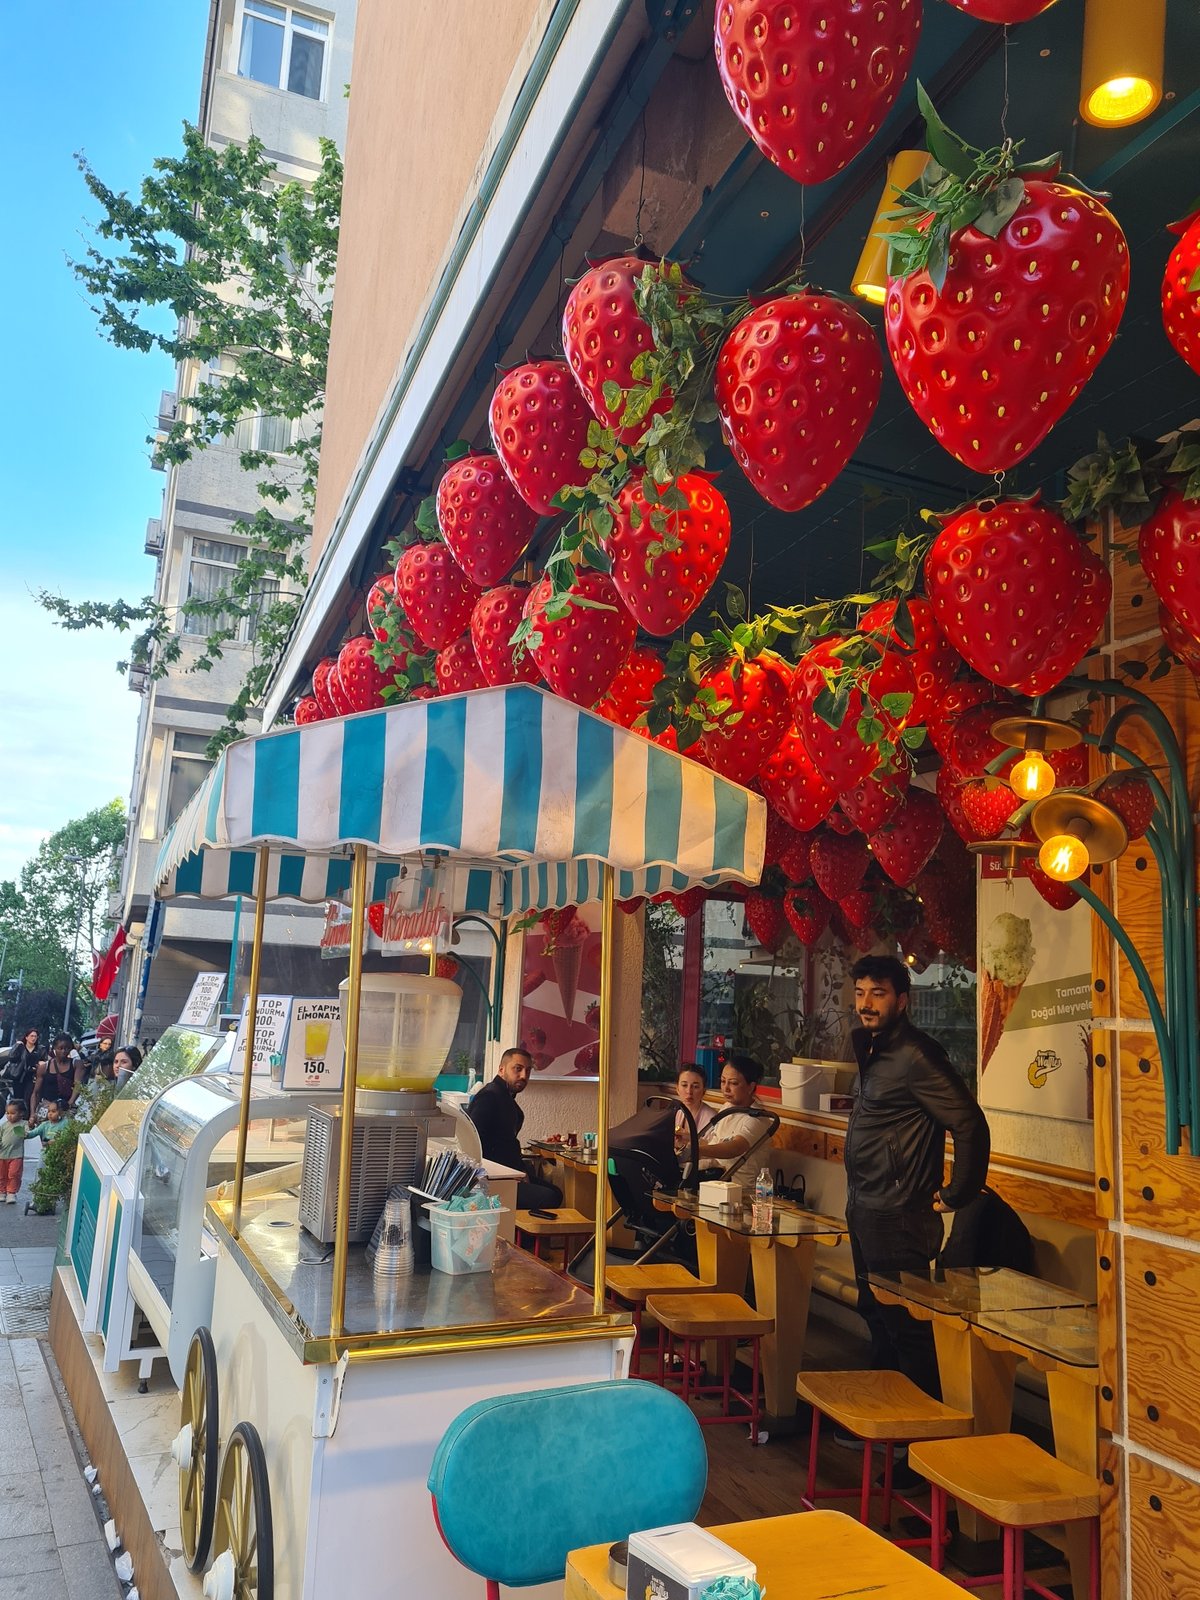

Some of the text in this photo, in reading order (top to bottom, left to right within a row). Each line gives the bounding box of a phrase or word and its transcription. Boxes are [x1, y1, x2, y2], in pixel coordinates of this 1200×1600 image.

[262, 1000, 282, 1009] TOP
[245, 1009, 285, 1018] DNDURMA
[1031, 1006, 1056, 1020] Doğal
[255, 1016, 272, 1026] 100
[255, 1030, 275, 1038] TOP
[241, 1038, 277, 1047] FTIKLI
[304, 1061, 325, 1074] 150
